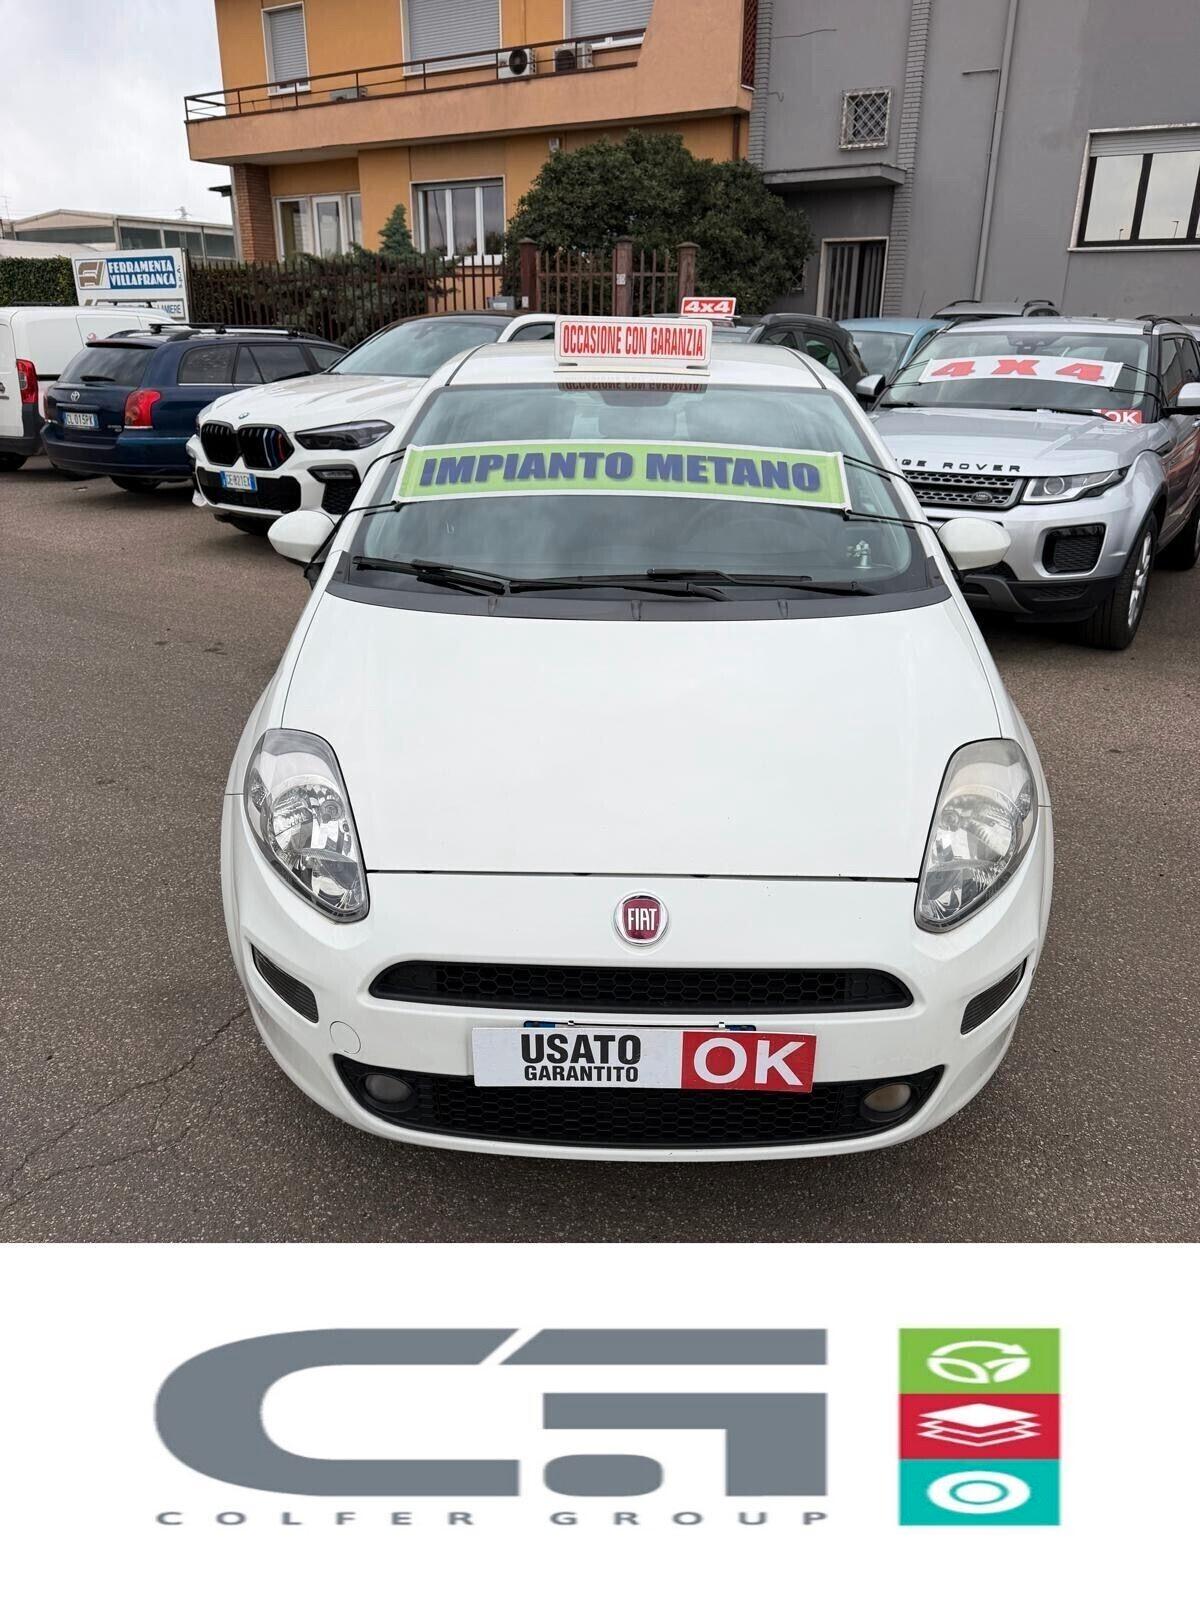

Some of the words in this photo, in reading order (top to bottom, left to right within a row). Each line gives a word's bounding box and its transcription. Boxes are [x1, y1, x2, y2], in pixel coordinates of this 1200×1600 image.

[108, 259, 173, 274] FERRAMENTA
[109, 273, 176, 286] VILLAFRANCA
[684, 301, 731, 313] 4x4
[563, 324, 622, 354] OCCASIONE
[625, 326, 647, 355] CON
[650, 326, 703, 357] GARANZIA
[1104, 411, 1139, 425] OK
[419, 451, 634, 486] IMPIANTO
[645, 452, 821, 493] METANO
[894, 458, 927, 467] GE
[942, 462, 1021, 473] ROVER
[627, 907, 658, 931] FIAT
[520, 1033, 642, 1065] USATO
[693, 1037, 804, 1087] OK
[524, 1064, 639, 1082] GARANTITO
